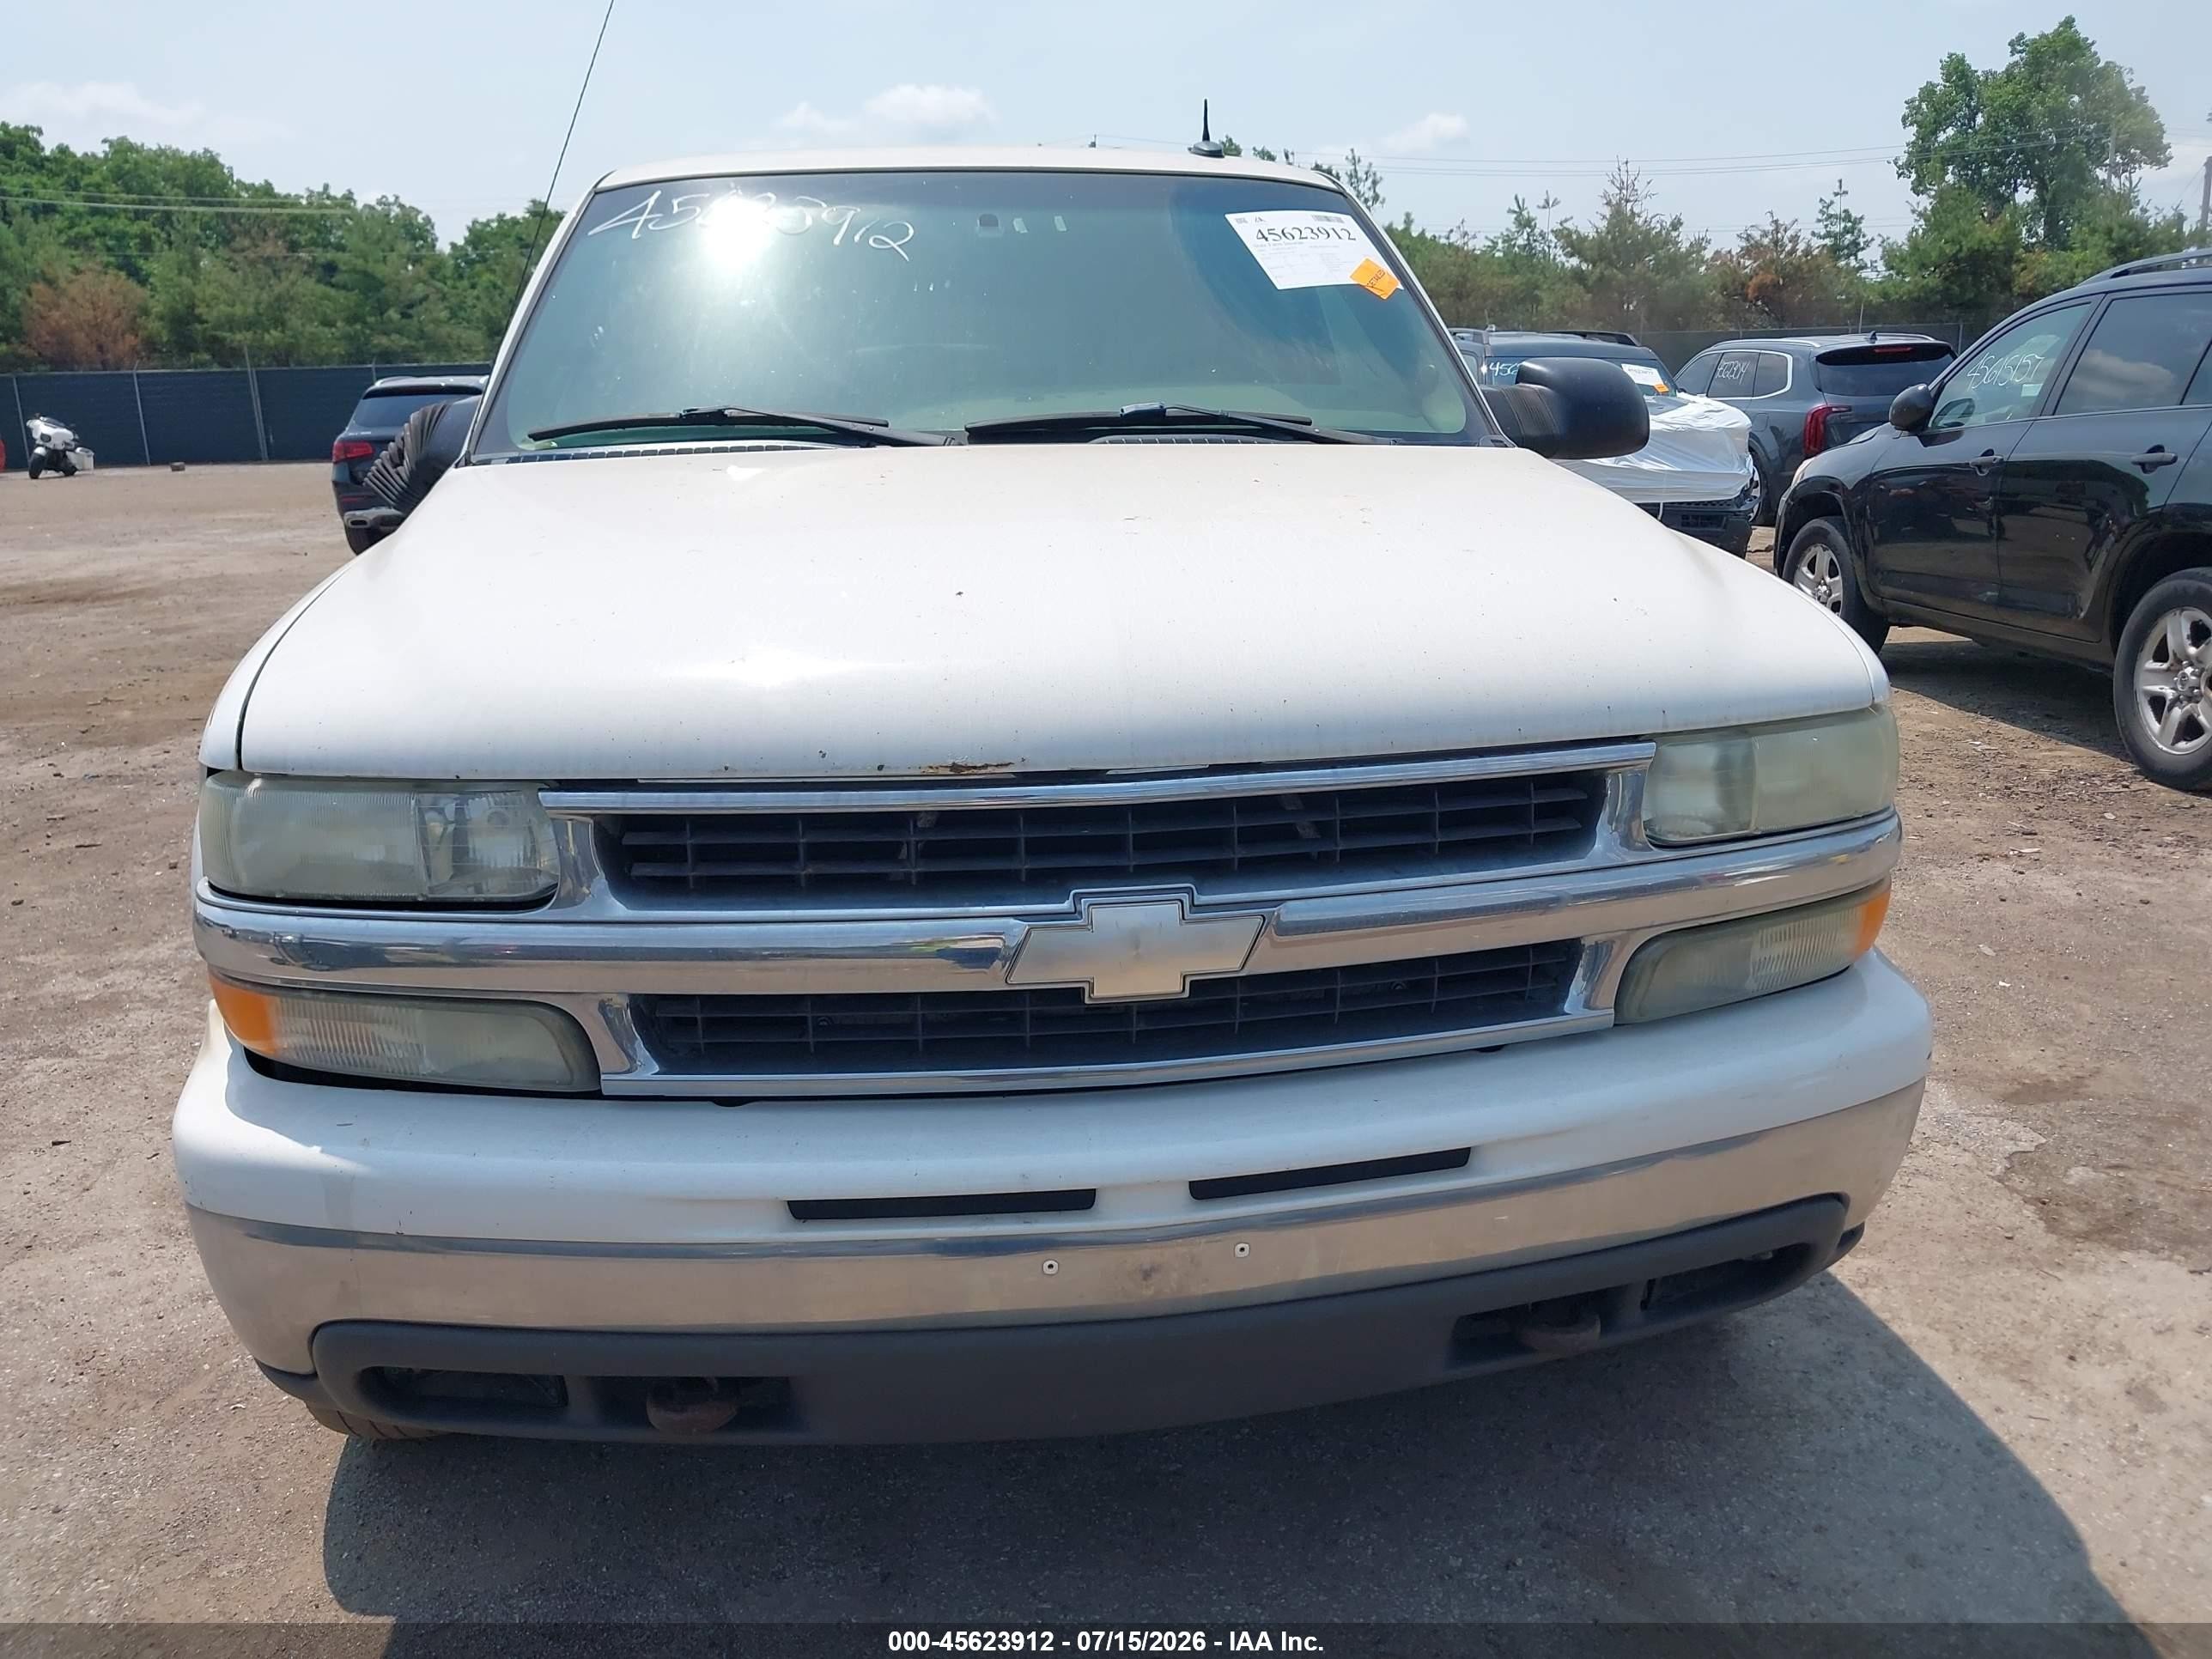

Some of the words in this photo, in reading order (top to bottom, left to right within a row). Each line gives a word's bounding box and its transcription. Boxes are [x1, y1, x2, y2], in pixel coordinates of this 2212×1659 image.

[1255, 227, 1357, 242] 45623912
[1489, 362, 1522, 377] 456
[1966, 352, 2045, 392] 45615157
